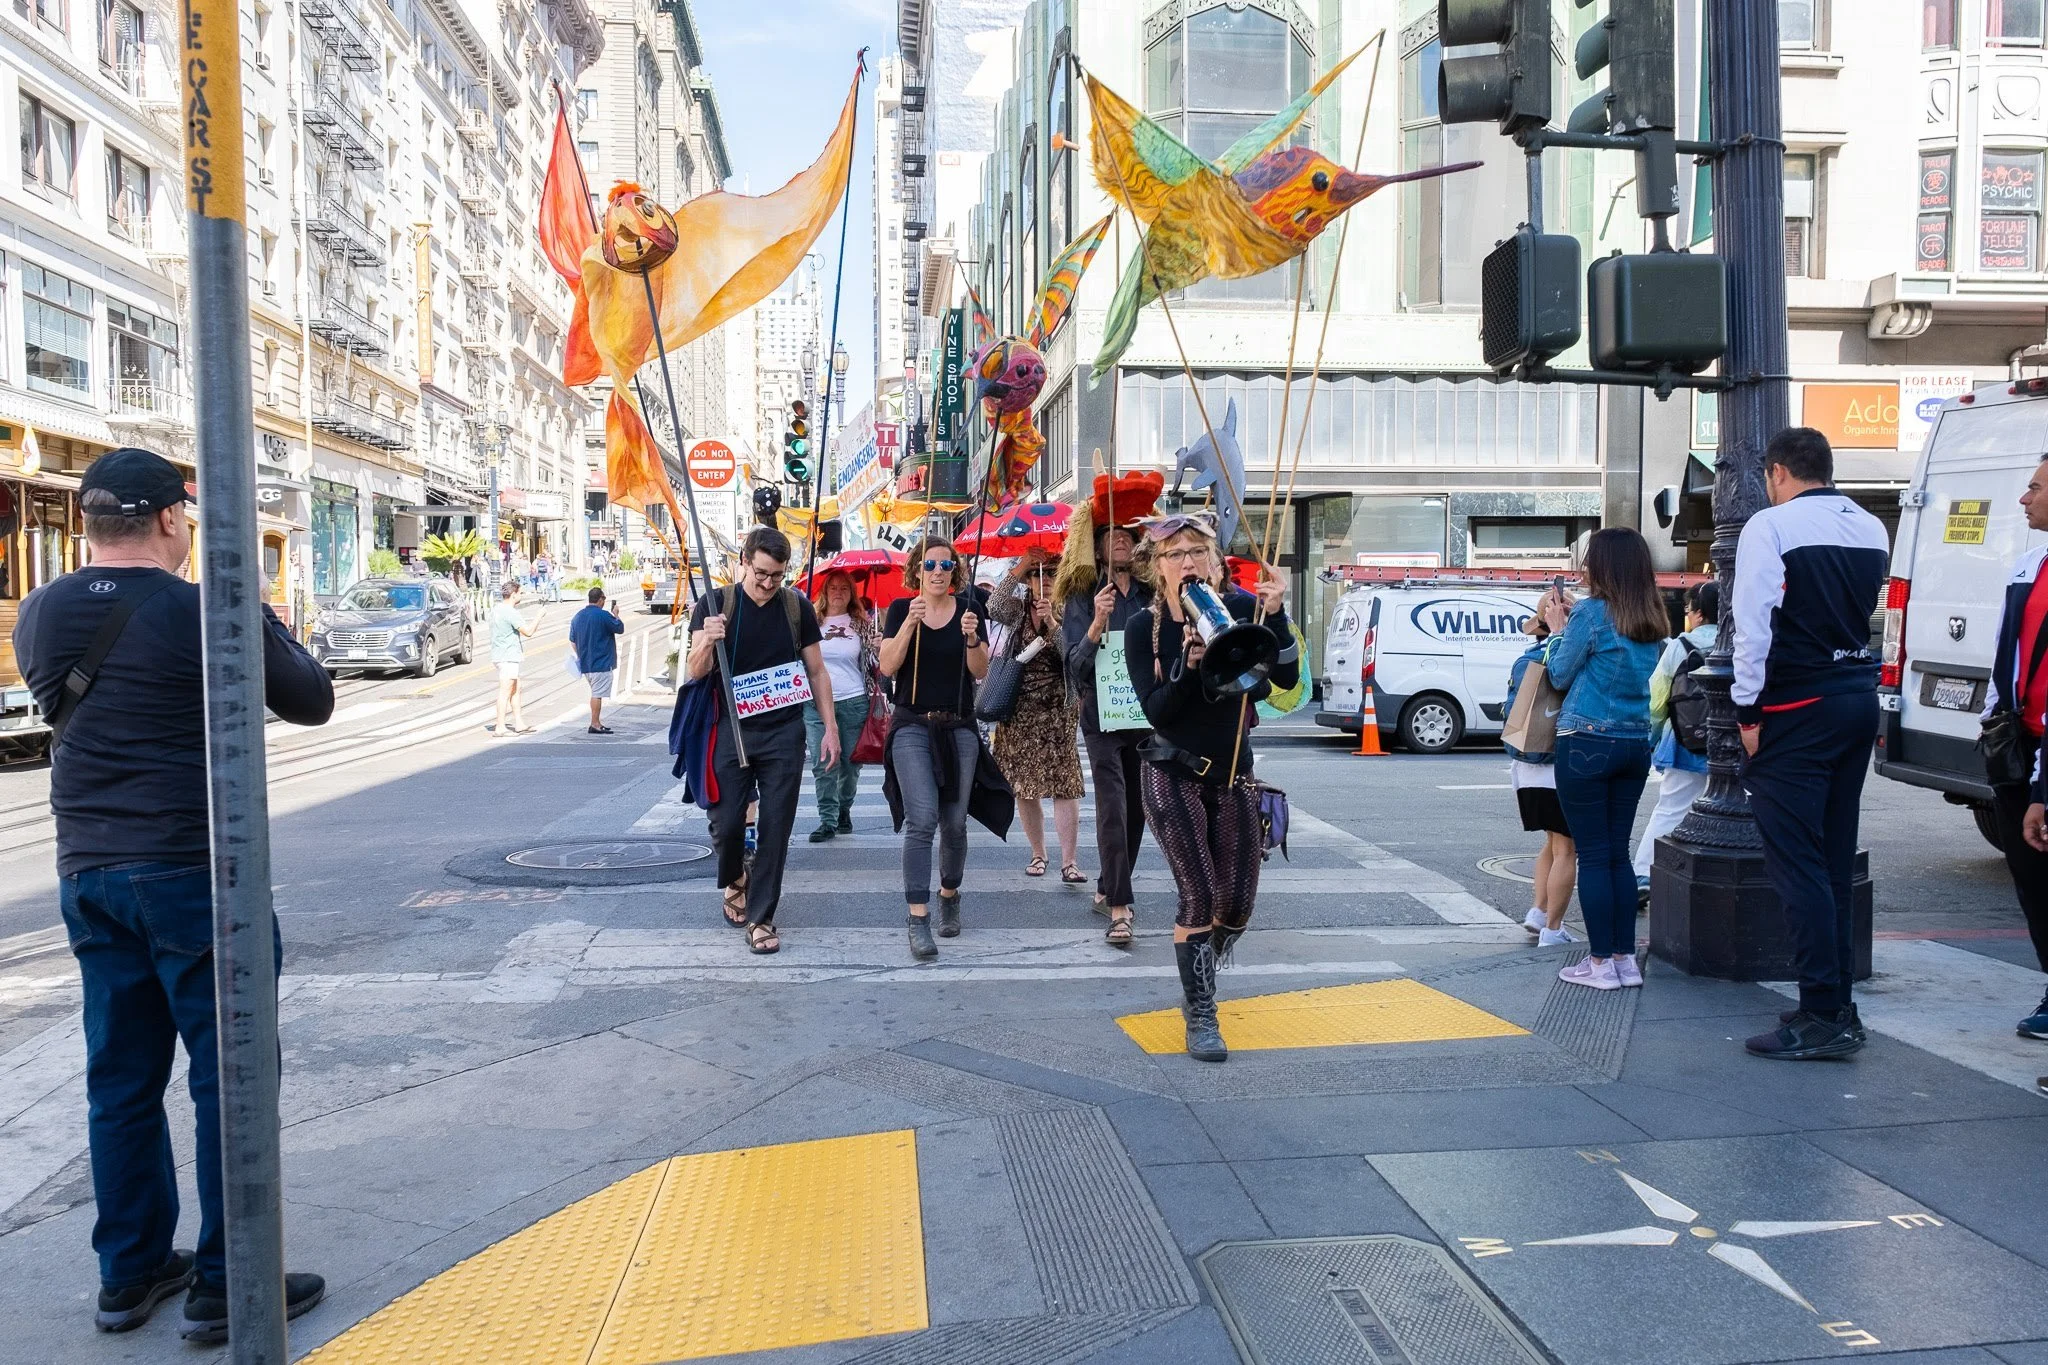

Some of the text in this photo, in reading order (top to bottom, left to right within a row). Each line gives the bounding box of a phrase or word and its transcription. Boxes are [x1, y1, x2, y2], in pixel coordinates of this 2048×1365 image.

[1924, 160, 1950, 169] PALM
[1982, 184, 2034, 199] PSYCHIC
[1921, 195, 1949, 206] READER
[1921, 222, 1946, 233] TAROT
[1980, 221, 2027, 234] FORTUNE
[1983, 234, 2023, 249] TELLER
[1920, 260, 1946, 270] READER
[946, 314, 959, 407] WINE SHOP
[1905, 377, 1968, 386] FOR LEASE
[908, 383, 916, 456] COCKTAILS
[1844, 425, 1878, 436] Organic
[694, 449, 729, 458] DO NOT
[839, 436, 877, 490] ENDANGERED
[697, 471, 726, 480] ENTER
[257, 488, 282, 502] GG
[877, 525, 912, 553] BLO
[860, 556, 886, 565] house
[732, 668, 792, 689] HUMANS ARE
[735, 686, 772, 701] CAUSING
[774, 680, 792, 691] THE
[1576, 1149, 1621, 1164] N
[1887, 1213, 1945, 1230] E
[1457, 1237, 1514, 1258] W
[1817, 1321, 1882, 1347] S
